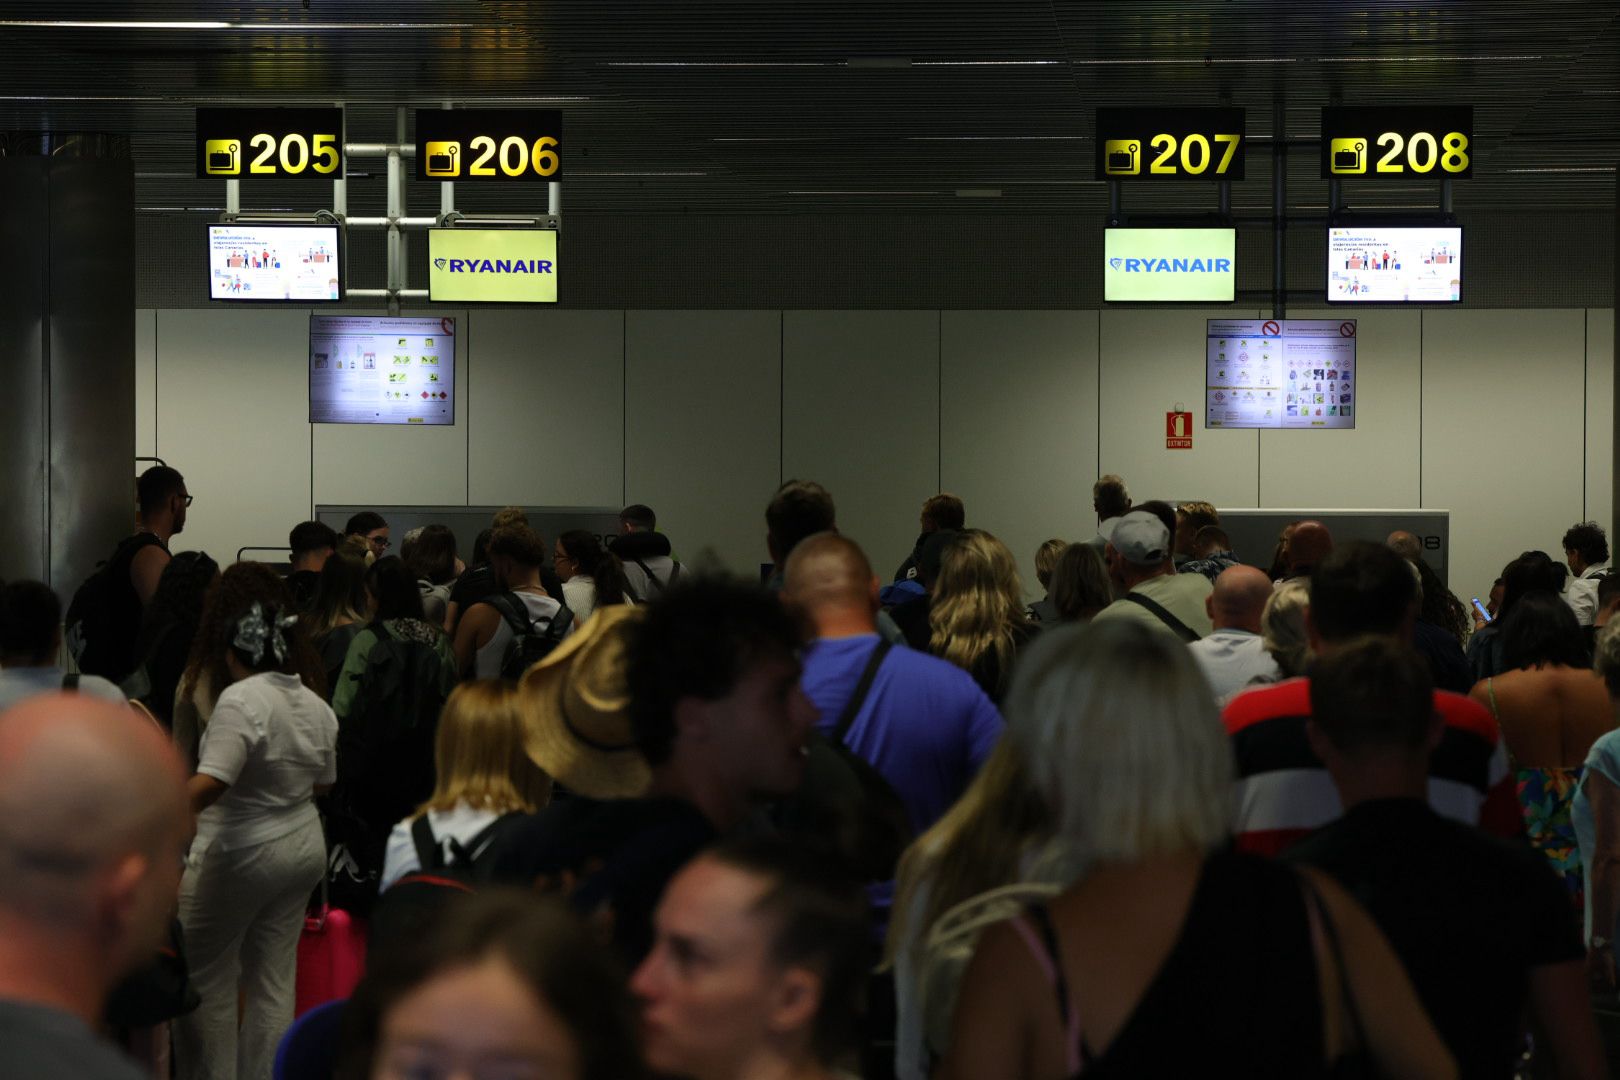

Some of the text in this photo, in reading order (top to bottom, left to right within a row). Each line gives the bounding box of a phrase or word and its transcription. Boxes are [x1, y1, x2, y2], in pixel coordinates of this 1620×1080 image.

[250, 133, 340, 175] 205
[469, 135, 559, 177] 206
[1150, 133, 1241, 174] 207
[1376, 131, 1469, 173] 208
[449, 258, 553, 274] RYANAIR
[1125, 258, 1231, 273] RYANAIR
